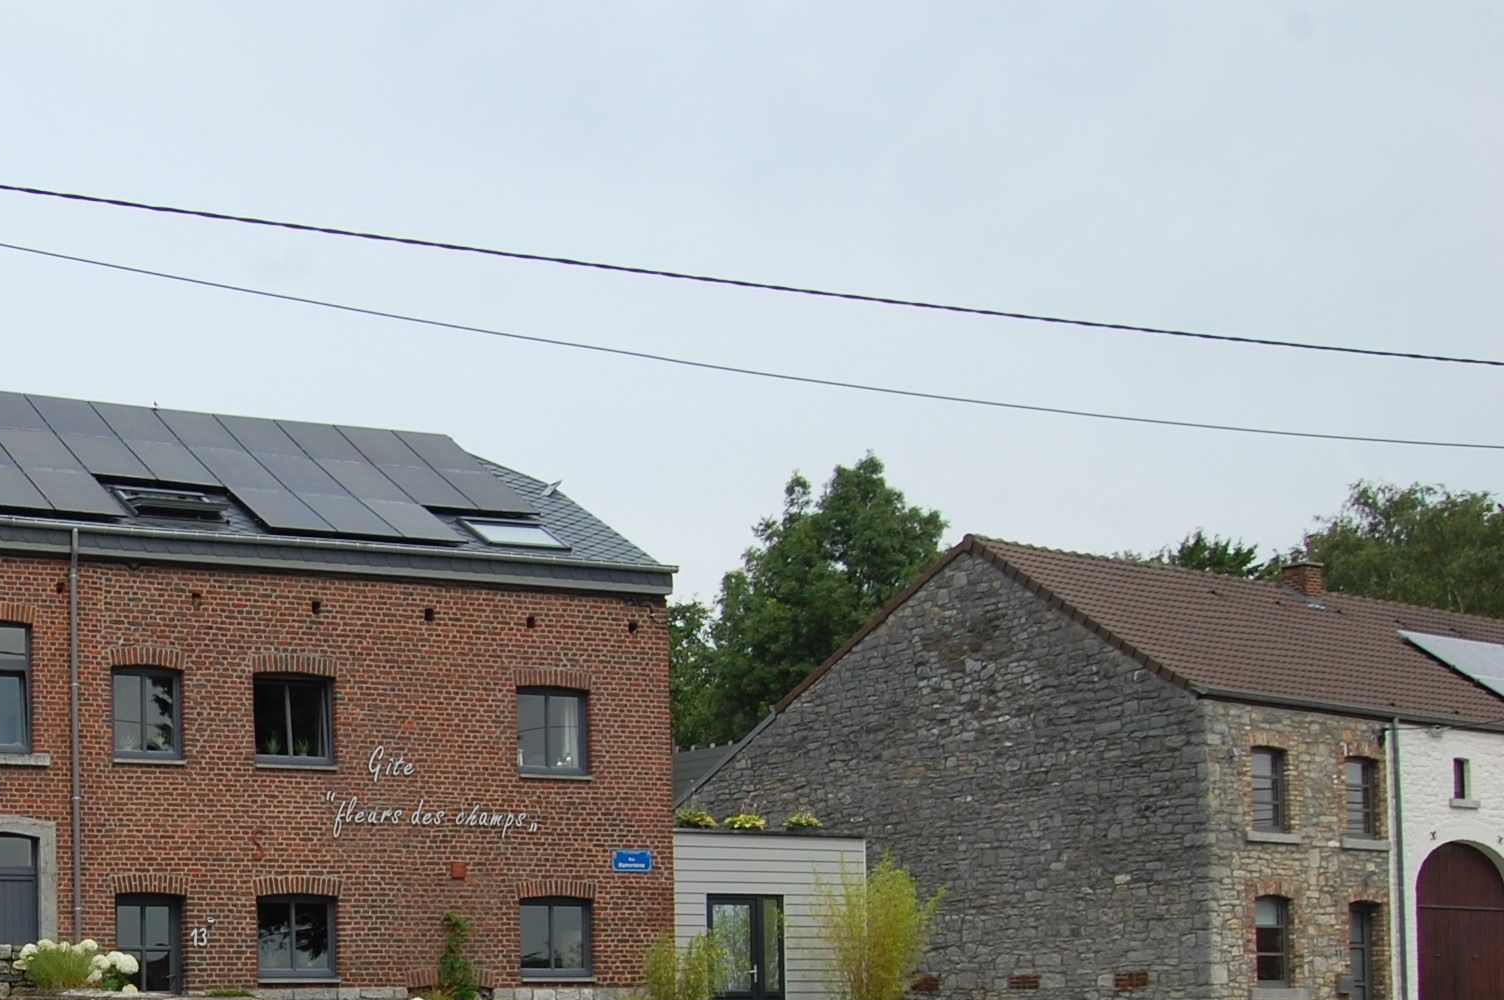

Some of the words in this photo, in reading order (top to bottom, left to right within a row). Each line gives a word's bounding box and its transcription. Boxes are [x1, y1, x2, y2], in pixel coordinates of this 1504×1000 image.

[368, 745, 415, 782] Gîte
[411, 799, 445, 825] des
[190, 927, 208, 946] 13
